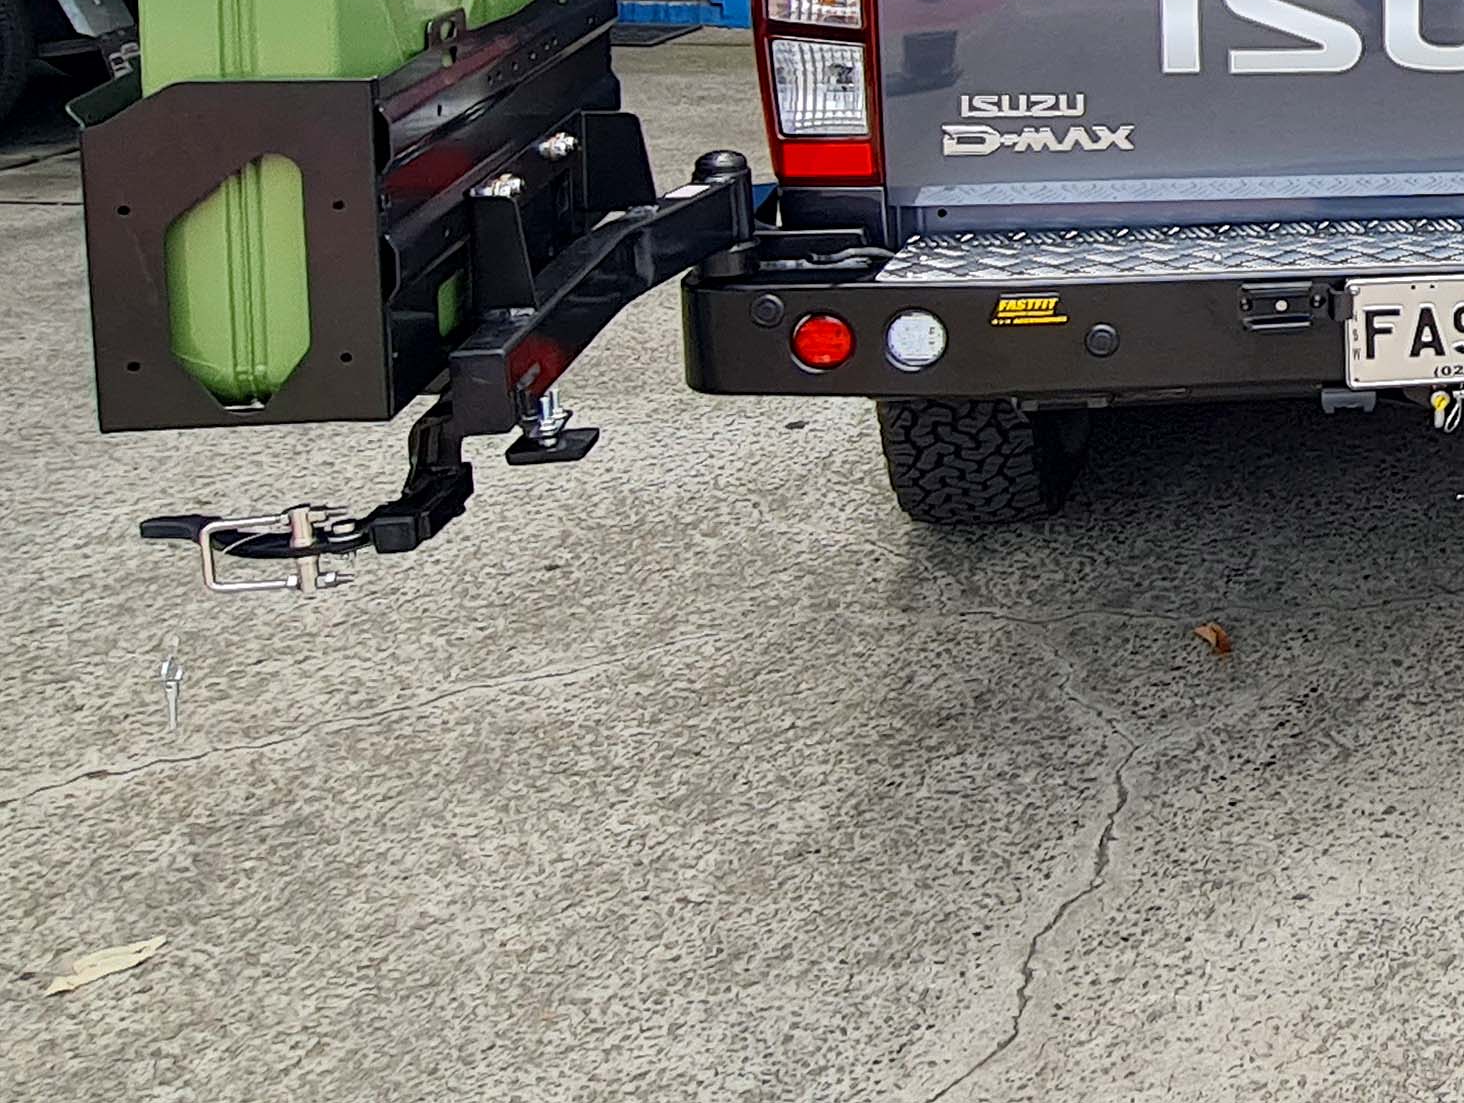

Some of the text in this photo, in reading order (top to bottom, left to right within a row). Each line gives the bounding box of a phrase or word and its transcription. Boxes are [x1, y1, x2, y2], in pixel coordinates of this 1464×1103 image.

[960, 93, 1085, 118] ISUZU
[941, 124, 1135, 156] D-MAX
[998, 297, 1060, 311] FASTFIT
